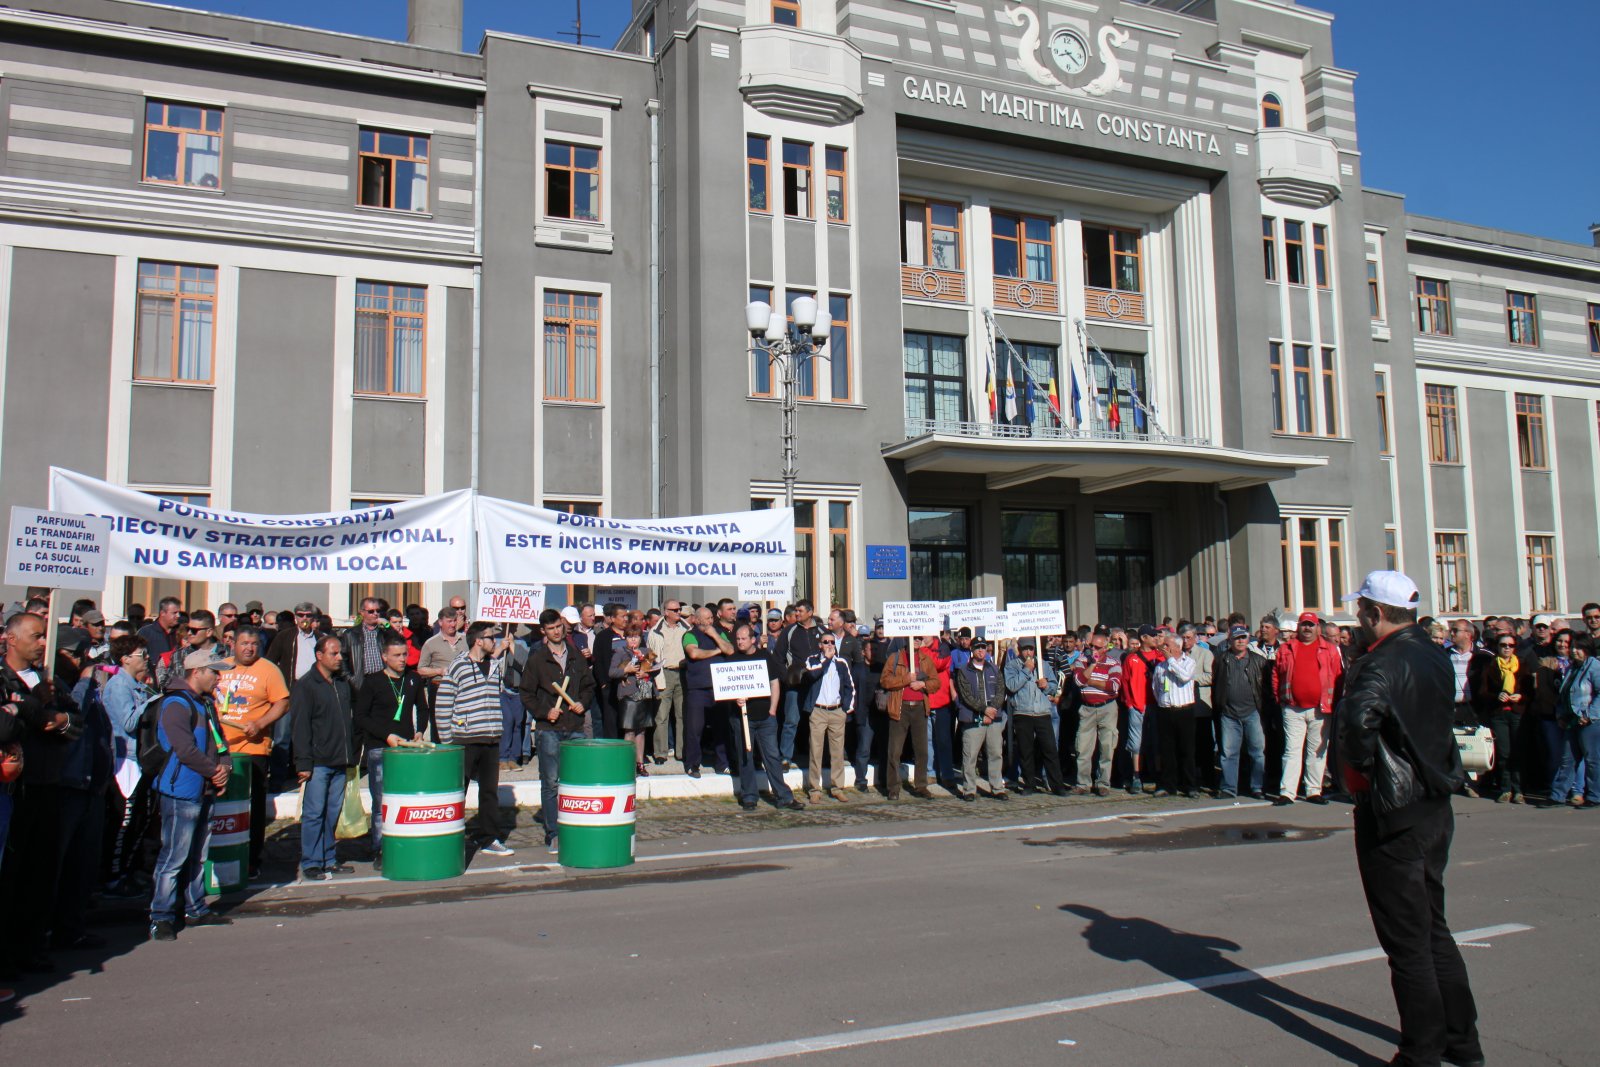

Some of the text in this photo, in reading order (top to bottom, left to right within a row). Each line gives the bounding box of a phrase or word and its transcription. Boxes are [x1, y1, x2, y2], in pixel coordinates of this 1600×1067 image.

[903, 76, 1221, 156] GARA MARITIMA CONSTANTA
[36, 515, 86, 529] PARFUMUL
[25, 526, 95, 541] DE TRANDAFIRI
[204, 529, 335, 548] STRATEGIC
[16, 537, 100, 554] E LA FEL DE AMAR
[505, 531, 787, 554] ESTE ÎNCHIS PENTRU VAPORUL
[35, 551, 82, 564] CA SUCUL
[134, 547, 408, 571] NU SAMBADROM LOCAL
[18, 562, 32, 572] DE
[34, 563, 89, 576] PORTOCALE
[560, 560, 737, 576] CU BARONII LOCALI
[483, 586, 541, 598] CONSTANTA PORT
[492, 594, 531, 609] MAFIA
[481, 606, 540, 620] FREE AREA!
[736, 664, 746, 672] NU
[727, 674, 755, 682] SUNTEM
[562, 798, 591, 811] Castrol
[408, 808, 445, 821] Castrol
